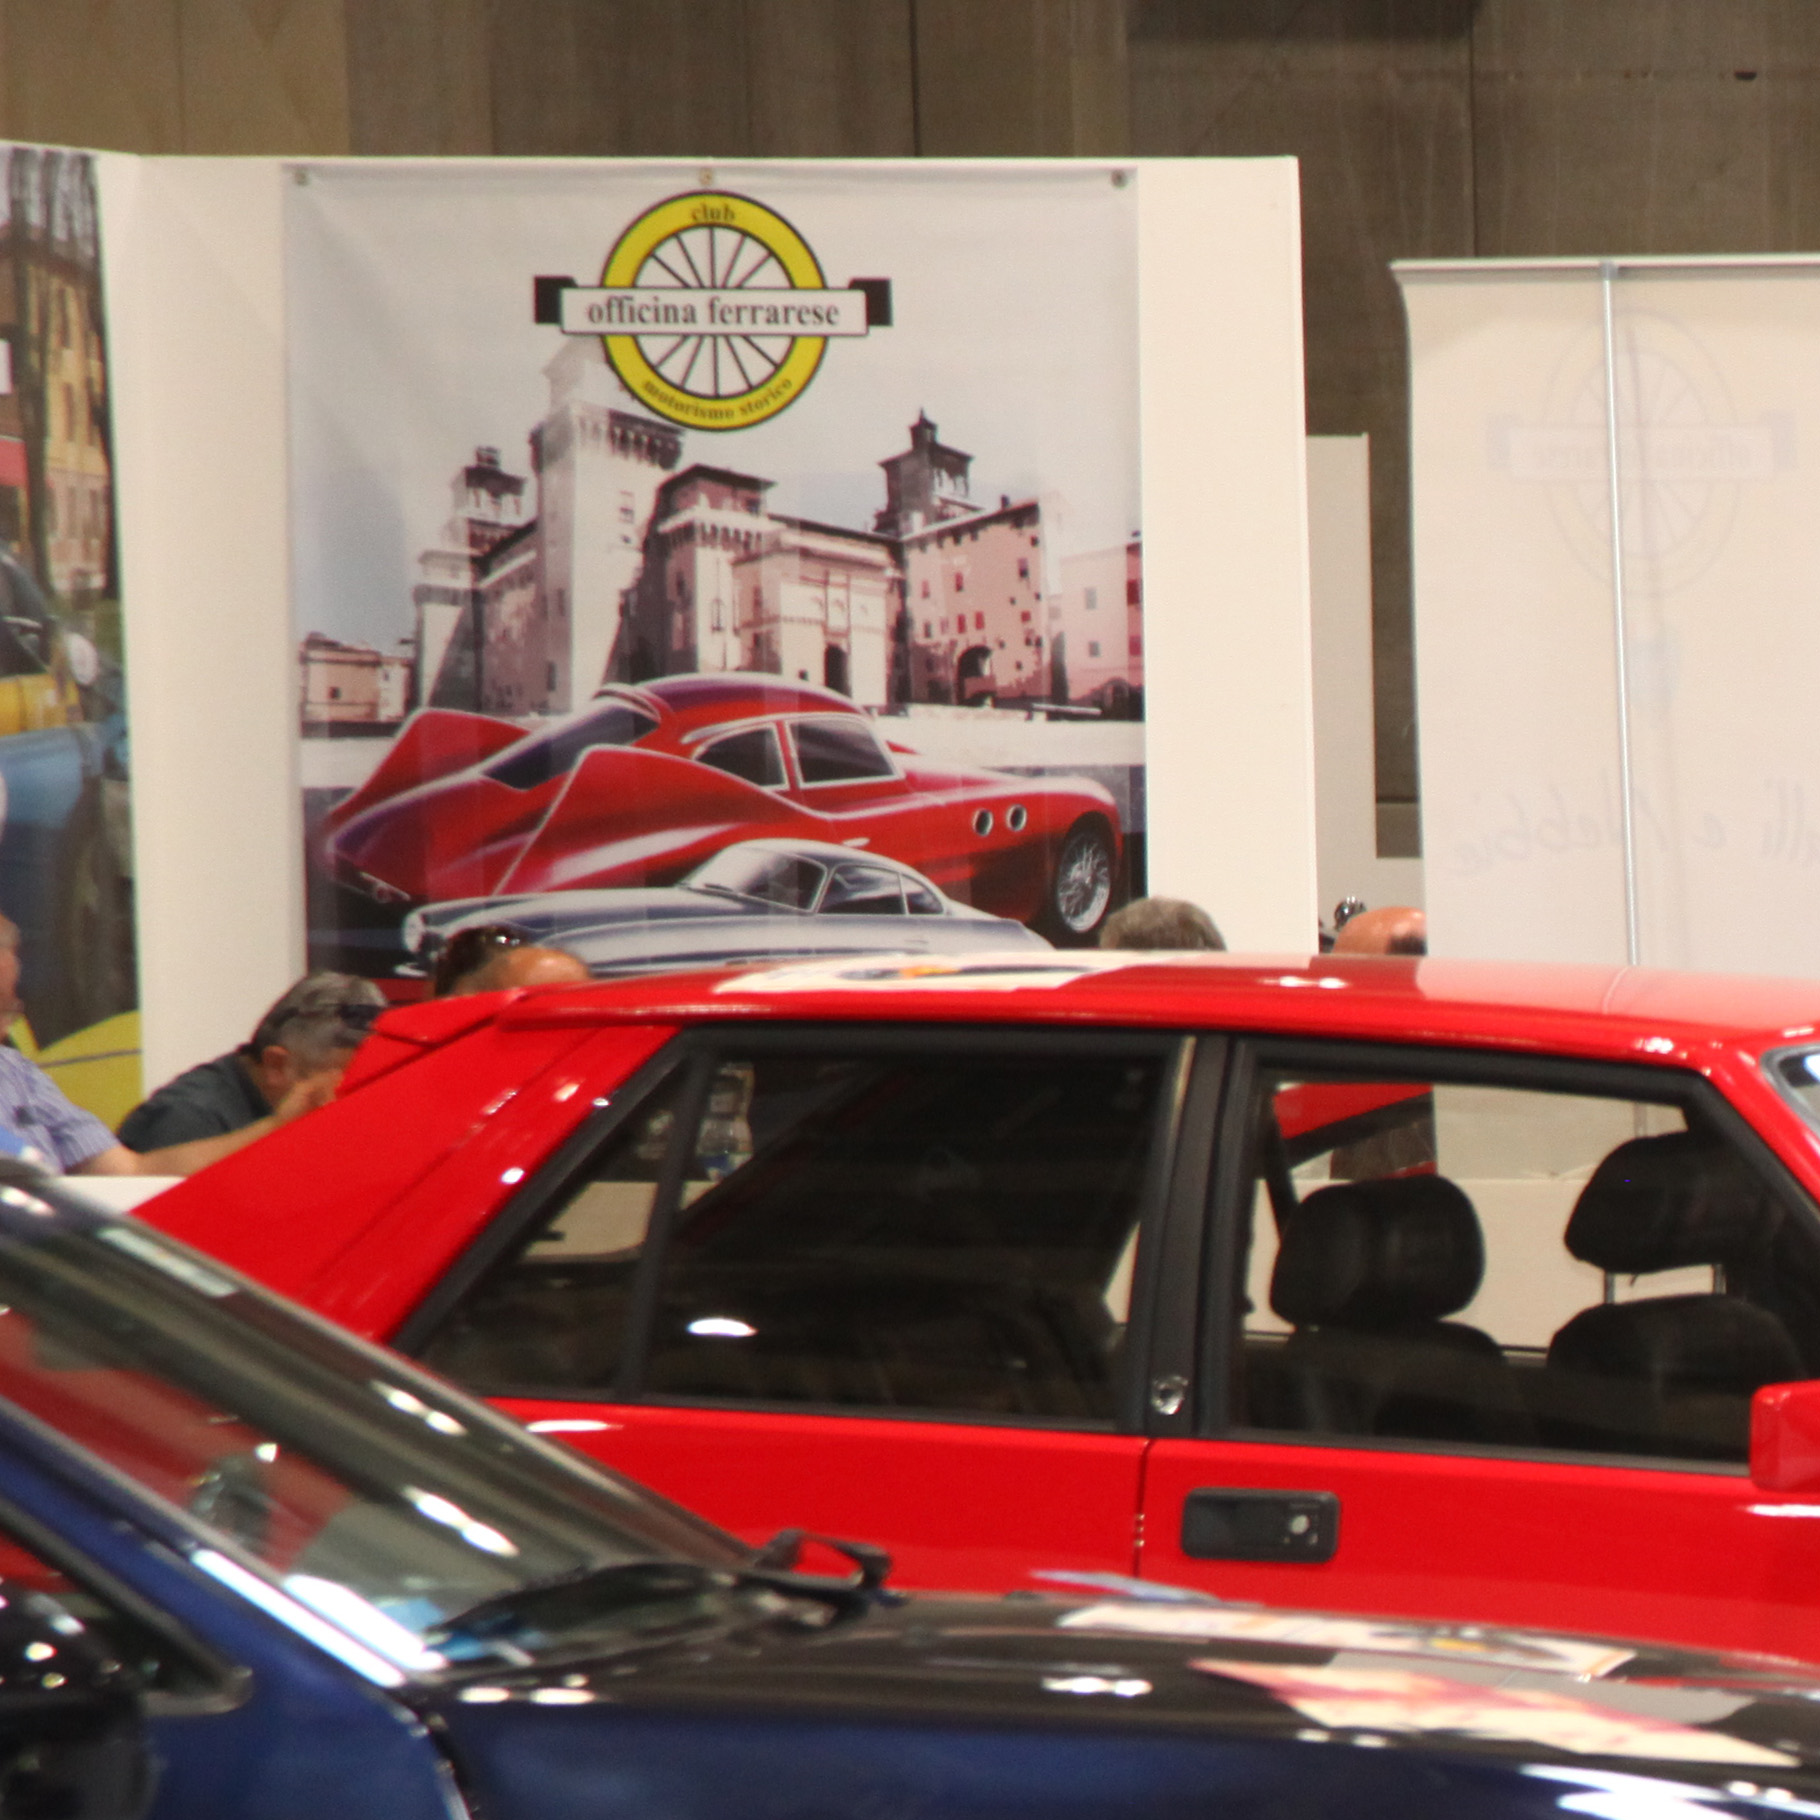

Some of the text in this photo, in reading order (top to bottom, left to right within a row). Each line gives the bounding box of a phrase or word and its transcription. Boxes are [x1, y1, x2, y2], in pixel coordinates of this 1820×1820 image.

[690, 202, 737, 223] club
[587, 295, 840, 326] officina ferrarese
[643, 377, 793, 421] motorismo storico
